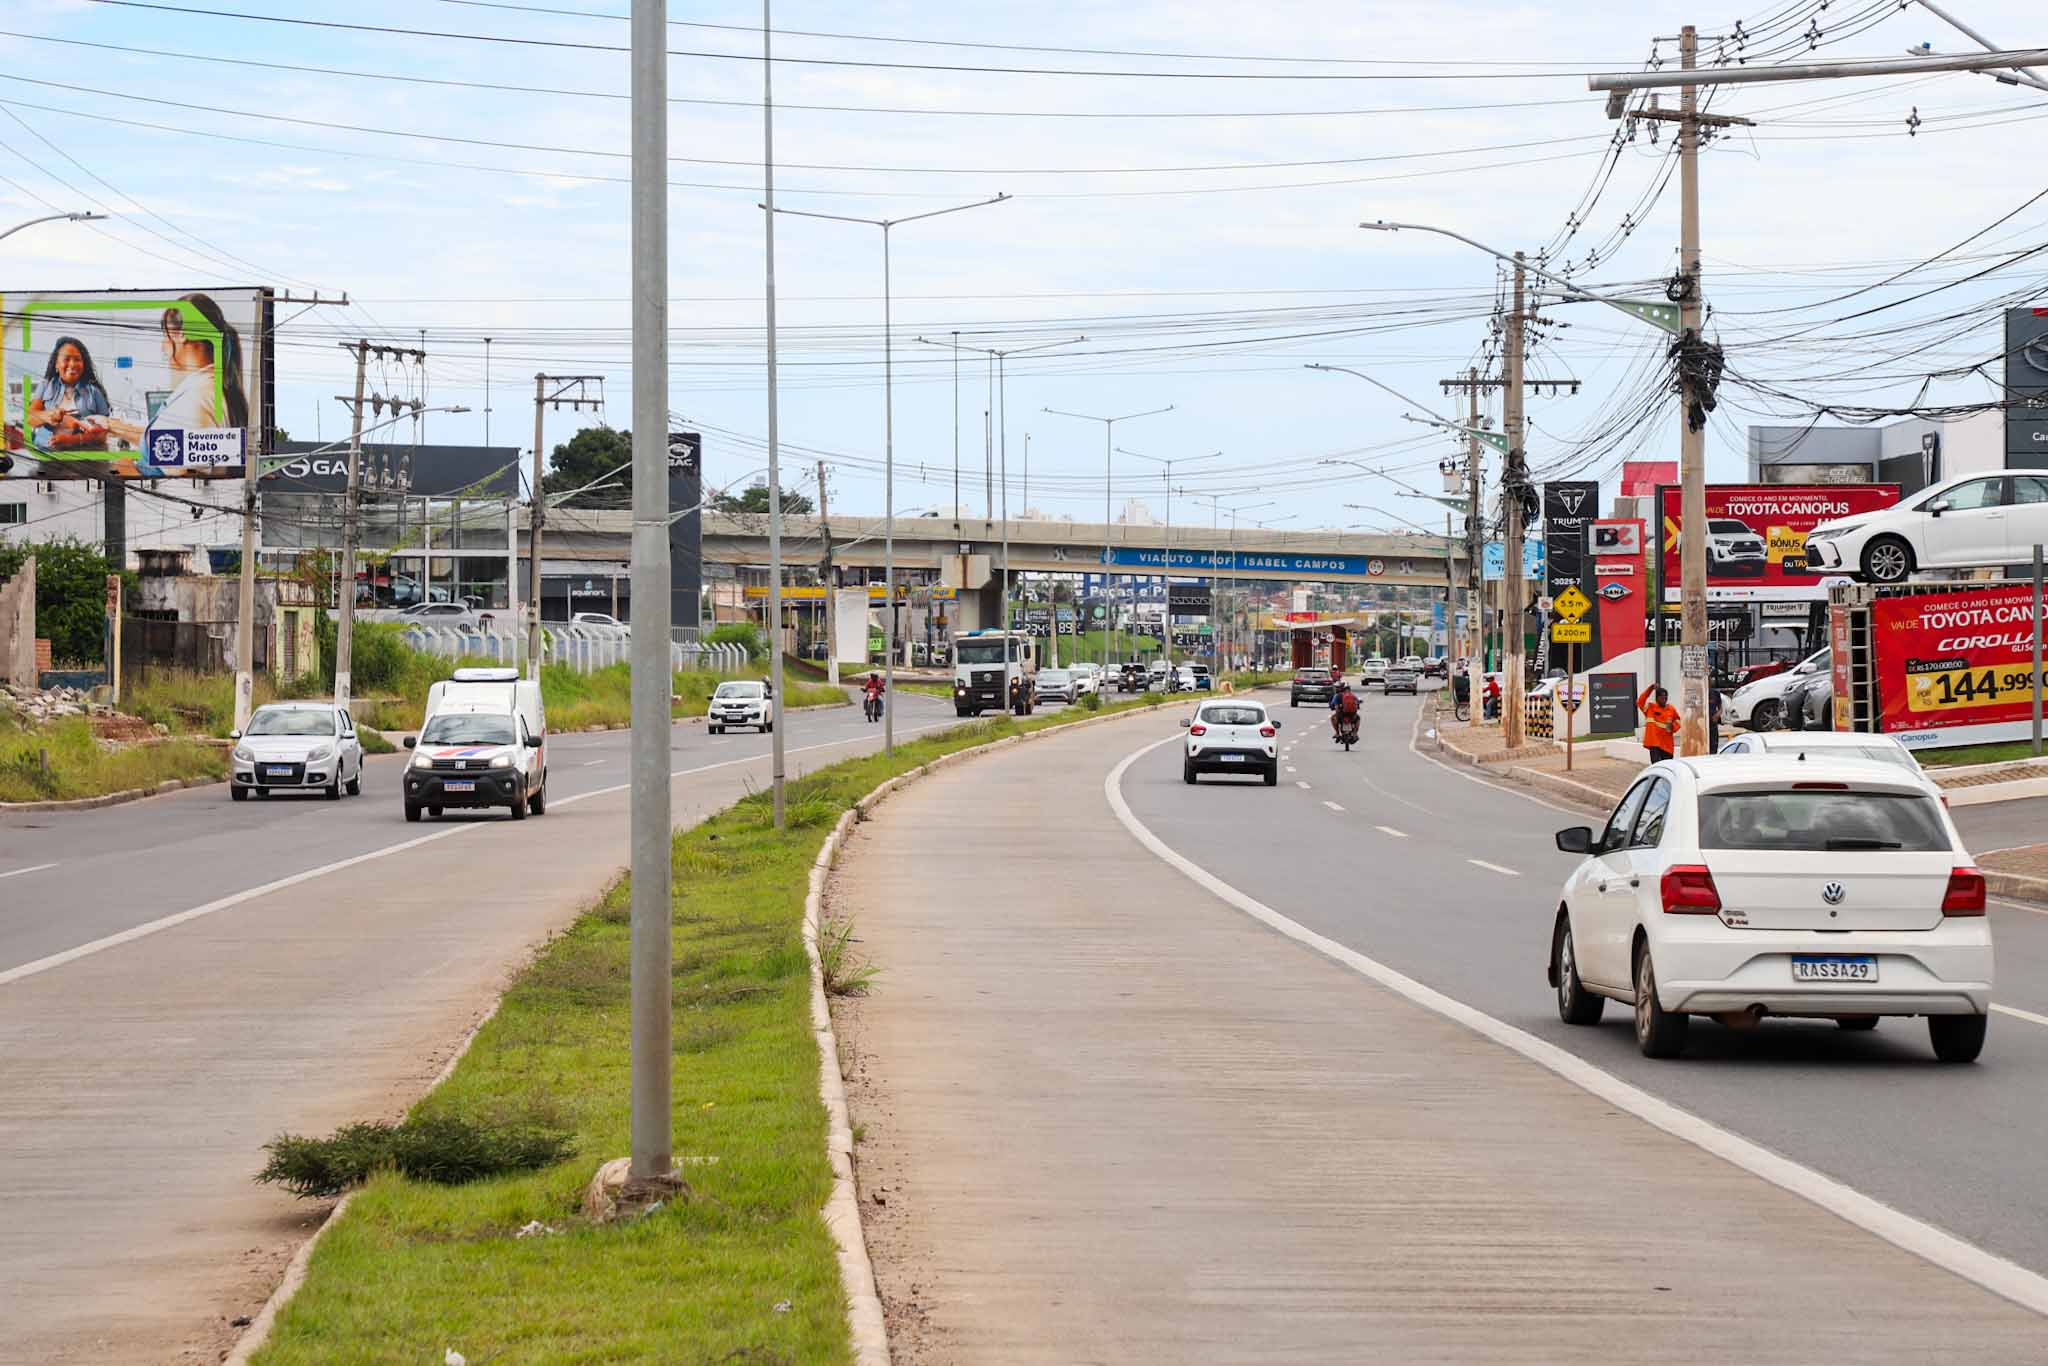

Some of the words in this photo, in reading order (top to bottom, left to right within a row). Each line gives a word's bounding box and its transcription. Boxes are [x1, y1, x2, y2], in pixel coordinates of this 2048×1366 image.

[188, 432, 224, 440] Governo
[226, 432, 236, 440] de
[188, 442, 218, 451] Mato
[188, 452, 229, 463] Grosso
[1726, 503, 1780, 516] TOYOTA
[1781, 502, 1849, 515] CANOPUS
[1770, 537, 1801, 548] BÔNUS
[1139, 553, 1194, 564] VIADUTO
[1243, 557, 1288, 568] ISABEL
[1295, 559, 1345, 570] CAMPOS
[1795, 560, 1808, 568] TAX
[1089, 586, 1134, 599] Peças
[1923, 602, 1960, 612] COMECE
[1961, 601, 1968, 609] O
[1970, 599, 1988, 609] ANO
[1990, 598, 2003, 607] EM
[1665, 618, 1725, 631] TRPH
[1890, 620, 1905, 631] VAI
[1905, 619, 1919, 629] DE
[1919, 609, 1996, 630] TOYOTA
[1563, 629, 1579, 637] 200
[1901, 732, 1938, 743] Canopus
[1800, 963, 1868, 978] RAS3A29
